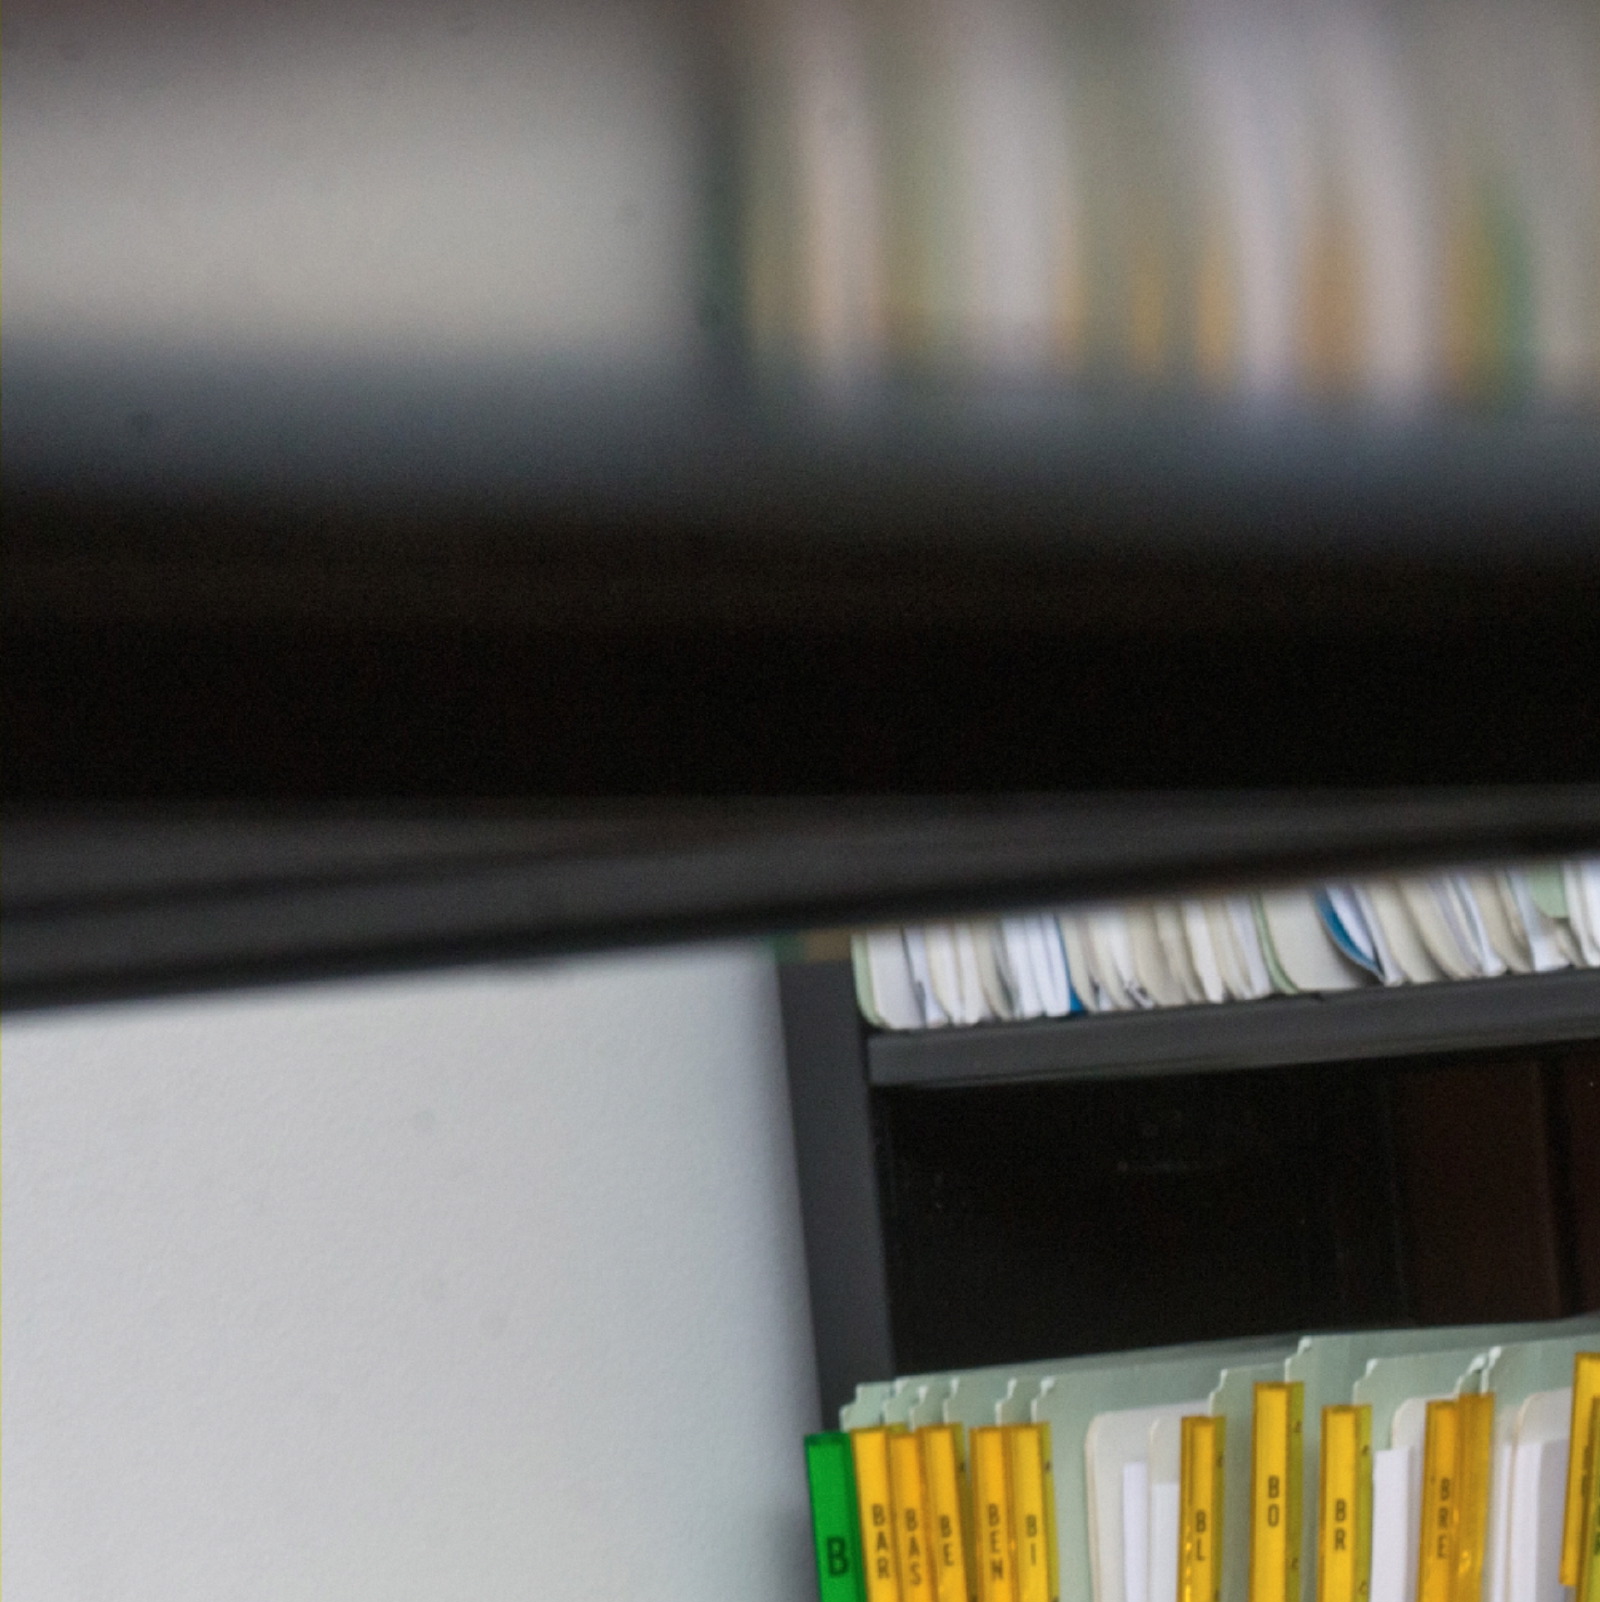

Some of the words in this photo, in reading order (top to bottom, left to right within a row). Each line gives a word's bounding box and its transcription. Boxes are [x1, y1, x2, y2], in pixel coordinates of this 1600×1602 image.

[1267, 1475, 1280, 1528] BO
[1333, 1499, 1347, 1552] BR
[1437, 1478, 1451, 1560] BRE
[826, 1537, 849, 1576] B
[871, 1504, 890, 1580] BAR
[904, 1508, 923, 1586] BAS
[939, 1515, 954, 1567] BE
[987, 1504, 1005, 1580] BEN
[1025, 1515, 1038, 1567] BI
[1195, 1510, 1207, 1562] BL
